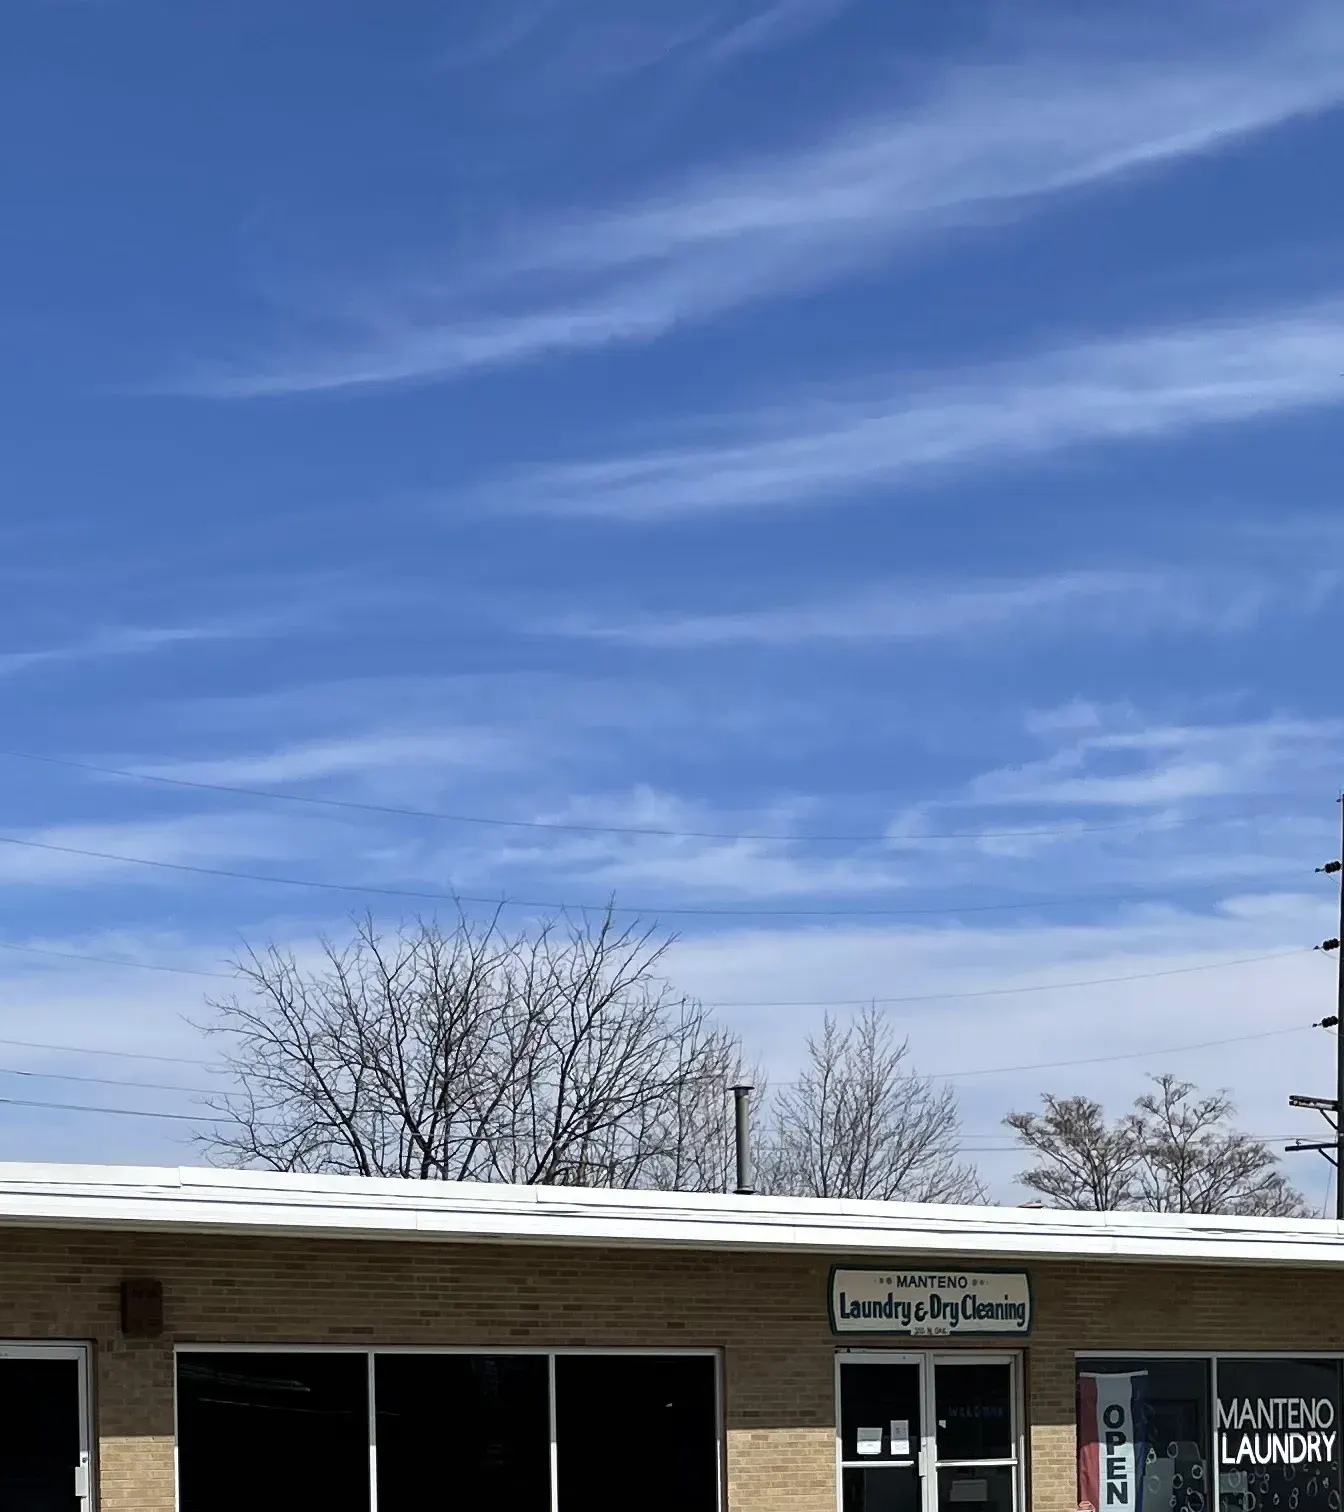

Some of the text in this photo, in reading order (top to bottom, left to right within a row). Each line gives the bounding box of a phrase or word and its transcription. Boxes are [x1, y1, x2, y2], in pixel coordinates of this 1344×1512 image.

[896, 1275, 968, 1289] MANTENO
[839, 1292, 1026, 1328] Laundry & Dry Cleaning
[1216, 1398, 1335, 1429] MANTENO
[1103, 1404, 1128, 1505] OPEN
[1221, 1430, 1337, 1465] LAUNDRY
